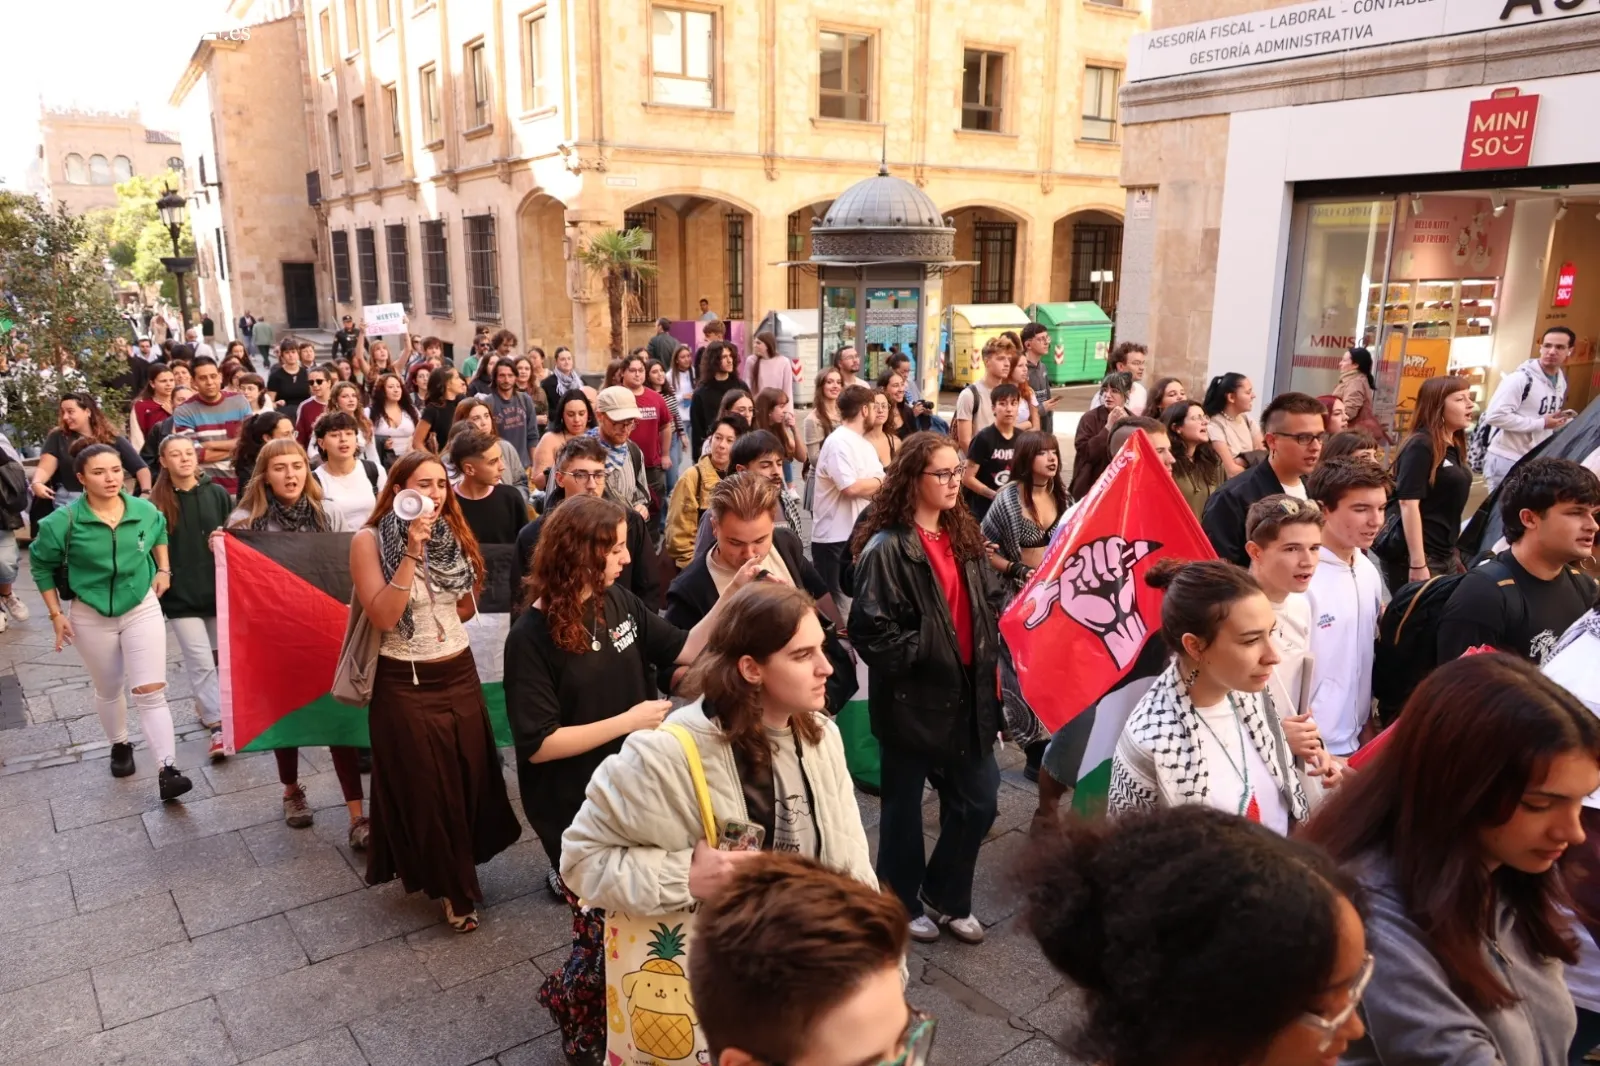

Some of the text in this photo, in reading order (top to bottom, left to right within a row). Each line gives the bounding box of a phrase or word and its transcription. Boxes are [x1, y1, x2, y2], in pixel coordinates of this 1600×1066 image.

[1147, 27, 1206, 50] ASESORÍA
[1210, 20, 1255, 39] FISCAL
[1269, 6, 1336, 29] LABORAL
[1353, 0, 1435, 15] CONT
[1189, 24, 1374, 65] GESTORÍA ADMINISTRATIVA
[1473, 110, 1529, 133] MINI
[1433, 220, 1450, 229] KITTY
[1413, 234, 1450, 244] AND FRIENDS
